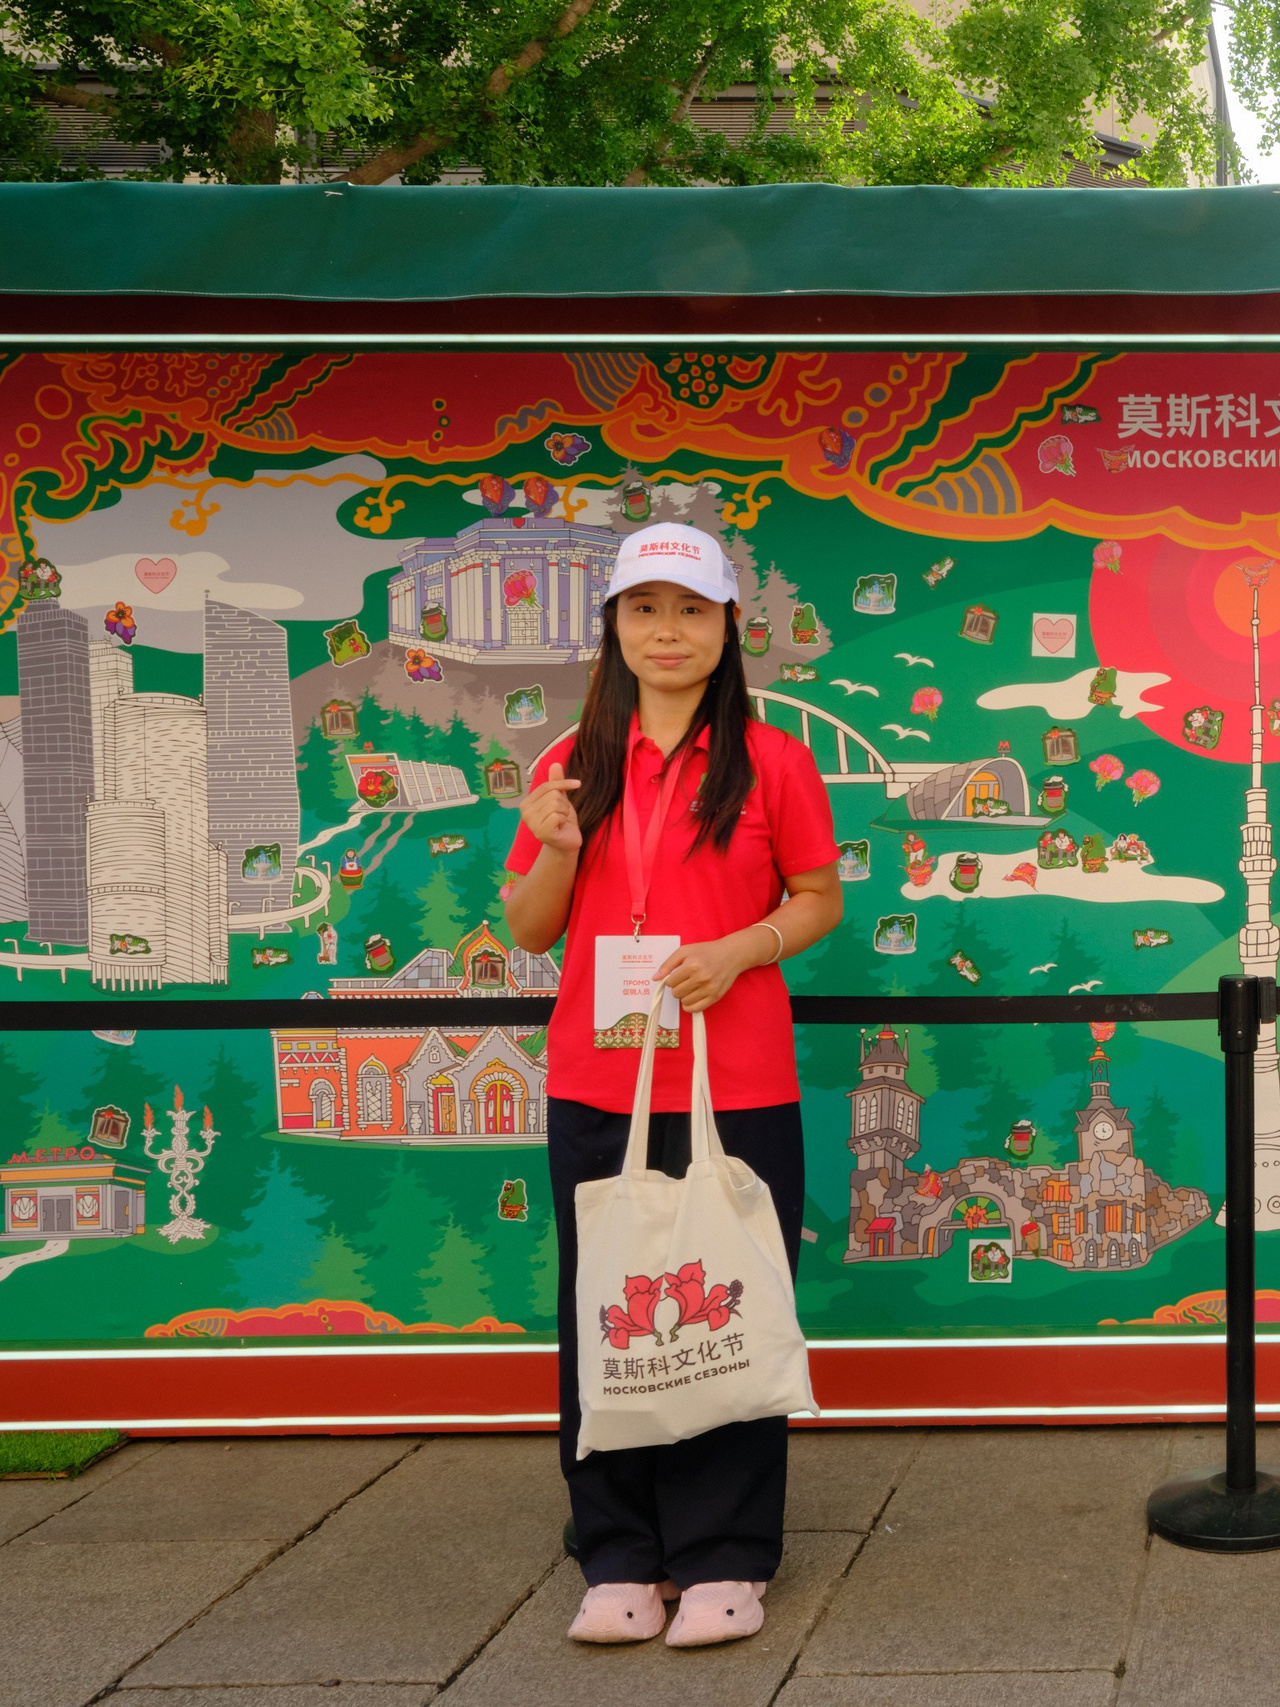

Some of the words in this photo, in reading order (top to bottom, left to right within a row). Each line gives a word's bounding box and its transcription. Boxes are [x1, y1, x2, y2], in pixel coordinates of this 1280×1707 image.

[639, 541, 701, 555] 莫斯科文化节
[7, 1145, 96, 1164] МЕТРО
[602, 1332, 745, 1380] 莫斯科文化节
[603, 1375, 692, 1395] МОСКОВСКИЕ
[694, 1358, 750, 1381] СЕЗОНЫ
